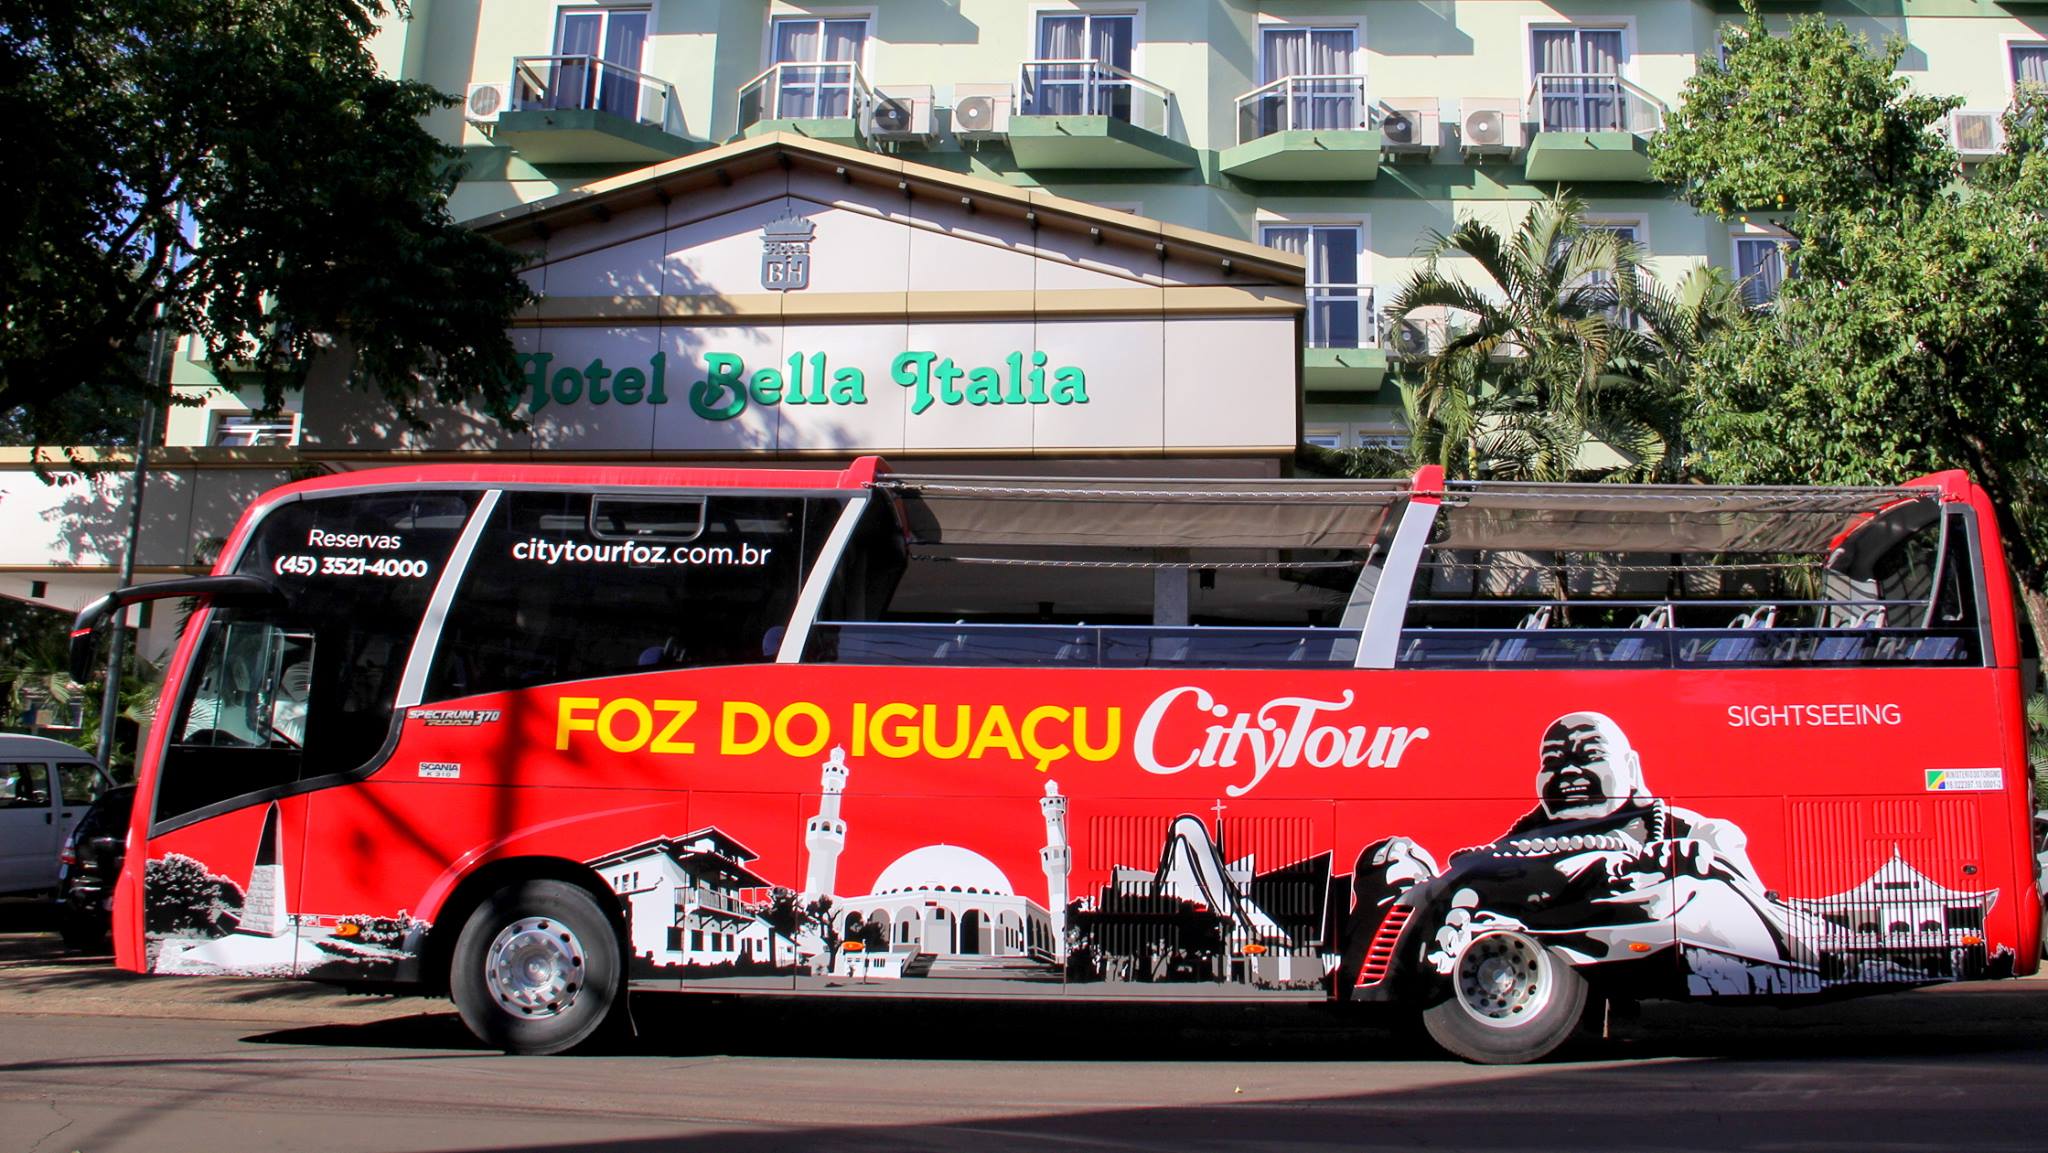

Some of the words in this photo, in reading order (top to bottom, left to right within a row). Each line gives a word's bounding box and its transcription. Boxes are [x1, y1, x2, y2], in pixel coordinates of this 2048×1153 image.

[486, 352, 668, 415] Hotel
[690, 352, 867, 421] Bella
[891, 351, 1089, 414] Italia
[308, 529, 402, 549] Reservas
[512, 537, 772, 568] citytourfoz.com.br
[275, 556, 318, 576] (45)
[320, 556, 429, 578] 3521-4000
[408, 710, 474, 719] SPECTRUM
[474, 711, 500, 726] 370
[1727, 703, 1902, 727] SIGHTSEEING
[556, 697, 698, 755] FOZ
[720, 701, 831, 758] DO
[851, 702, 1121, 773] IGUAÇU
[421, 763, 458, 771] SCANIA
